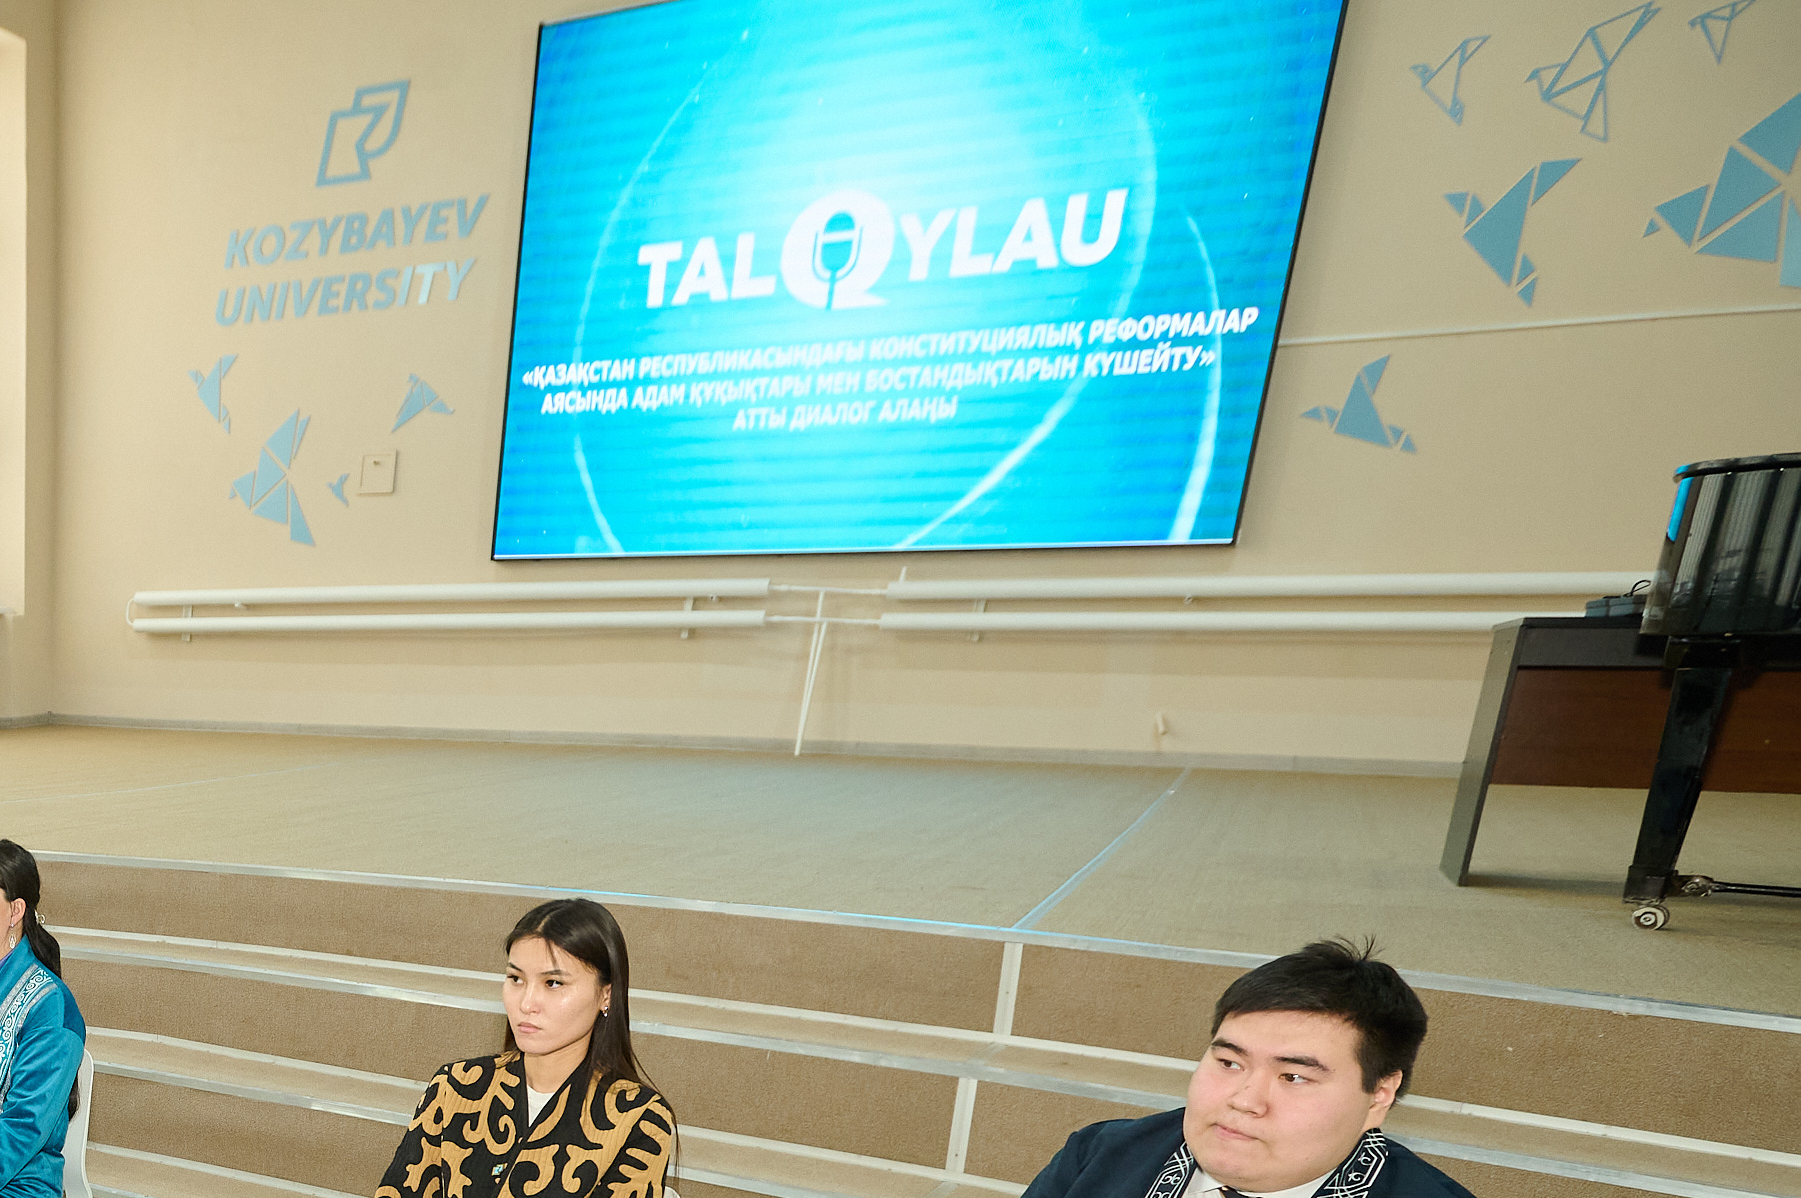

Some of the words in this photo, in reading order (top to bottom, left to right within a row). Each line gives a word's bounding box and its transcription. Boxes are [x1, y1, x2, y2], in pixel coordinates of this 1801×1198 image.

[223, 193, 490, 270] KOZYBAYEV
[637, 188, 1129, 311] TALQYLAU
[215, 257, 477, 327] UNIVERSITY
[522, 357, 636, 390] «ҚАЗАҚСТАН
[638, 339, 865, 380] РЕСПУБЛИКАСЫНДАҒЫ
[868, 320, 1086, 362] КОНСТИТУЦИЯЛЫҚ
[1087, 306, 1260, 345] РЕФОРМАЛАР
[540, 386, 629, 415] АЯСЫНДА
[631, 383, 687, 412] АДАМ
[815, 371, 861, 396] МЕН
[863, 354, 1079, 393] БОСТАНДЫҚТАРЫН
[732, 405, 787, 431] АТТЫ
[789, 400, 877, 432] ДИАЛОГ
[877, 395, 959, 424] АЛАҢЫ
